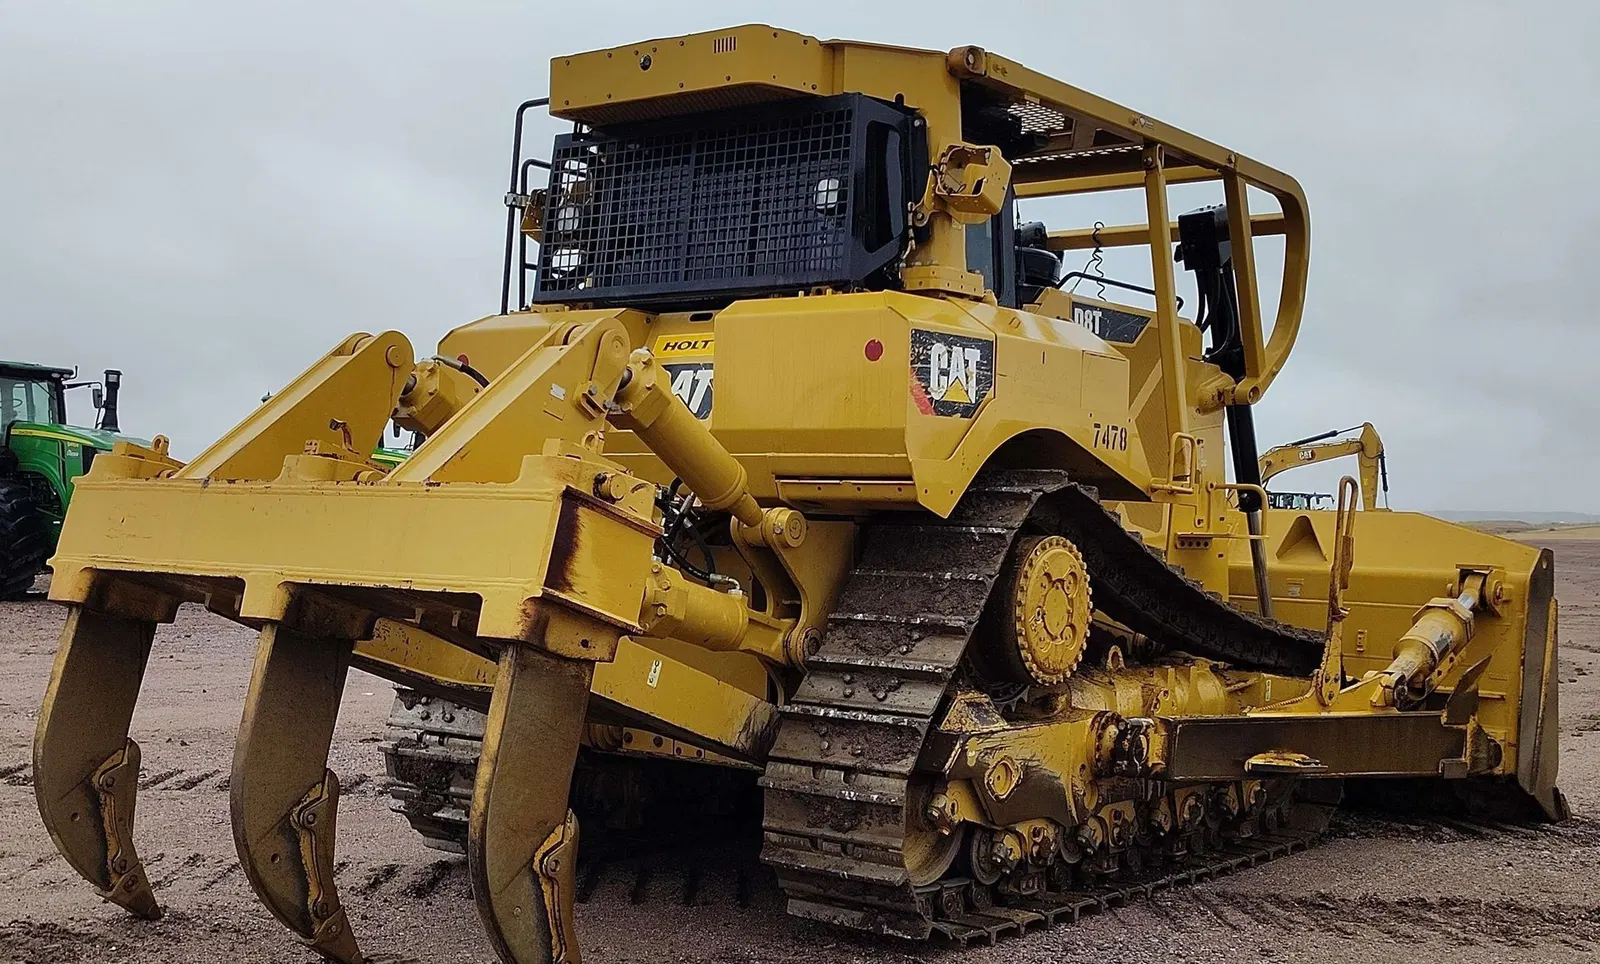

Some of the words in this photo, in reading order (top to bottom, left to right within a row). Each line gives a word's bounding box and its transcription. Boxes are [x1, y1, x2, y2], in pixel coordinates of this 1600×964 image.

[1074, 307, 1103, 335] D8T
[662, 340, 714, 351] HOLT
[929, 342, 981, 404] CAT
[671, 369, 714, 414] AT
[1093, 422, 1128, 452] 7478
[1298, 449, 1312, 461] CAT
